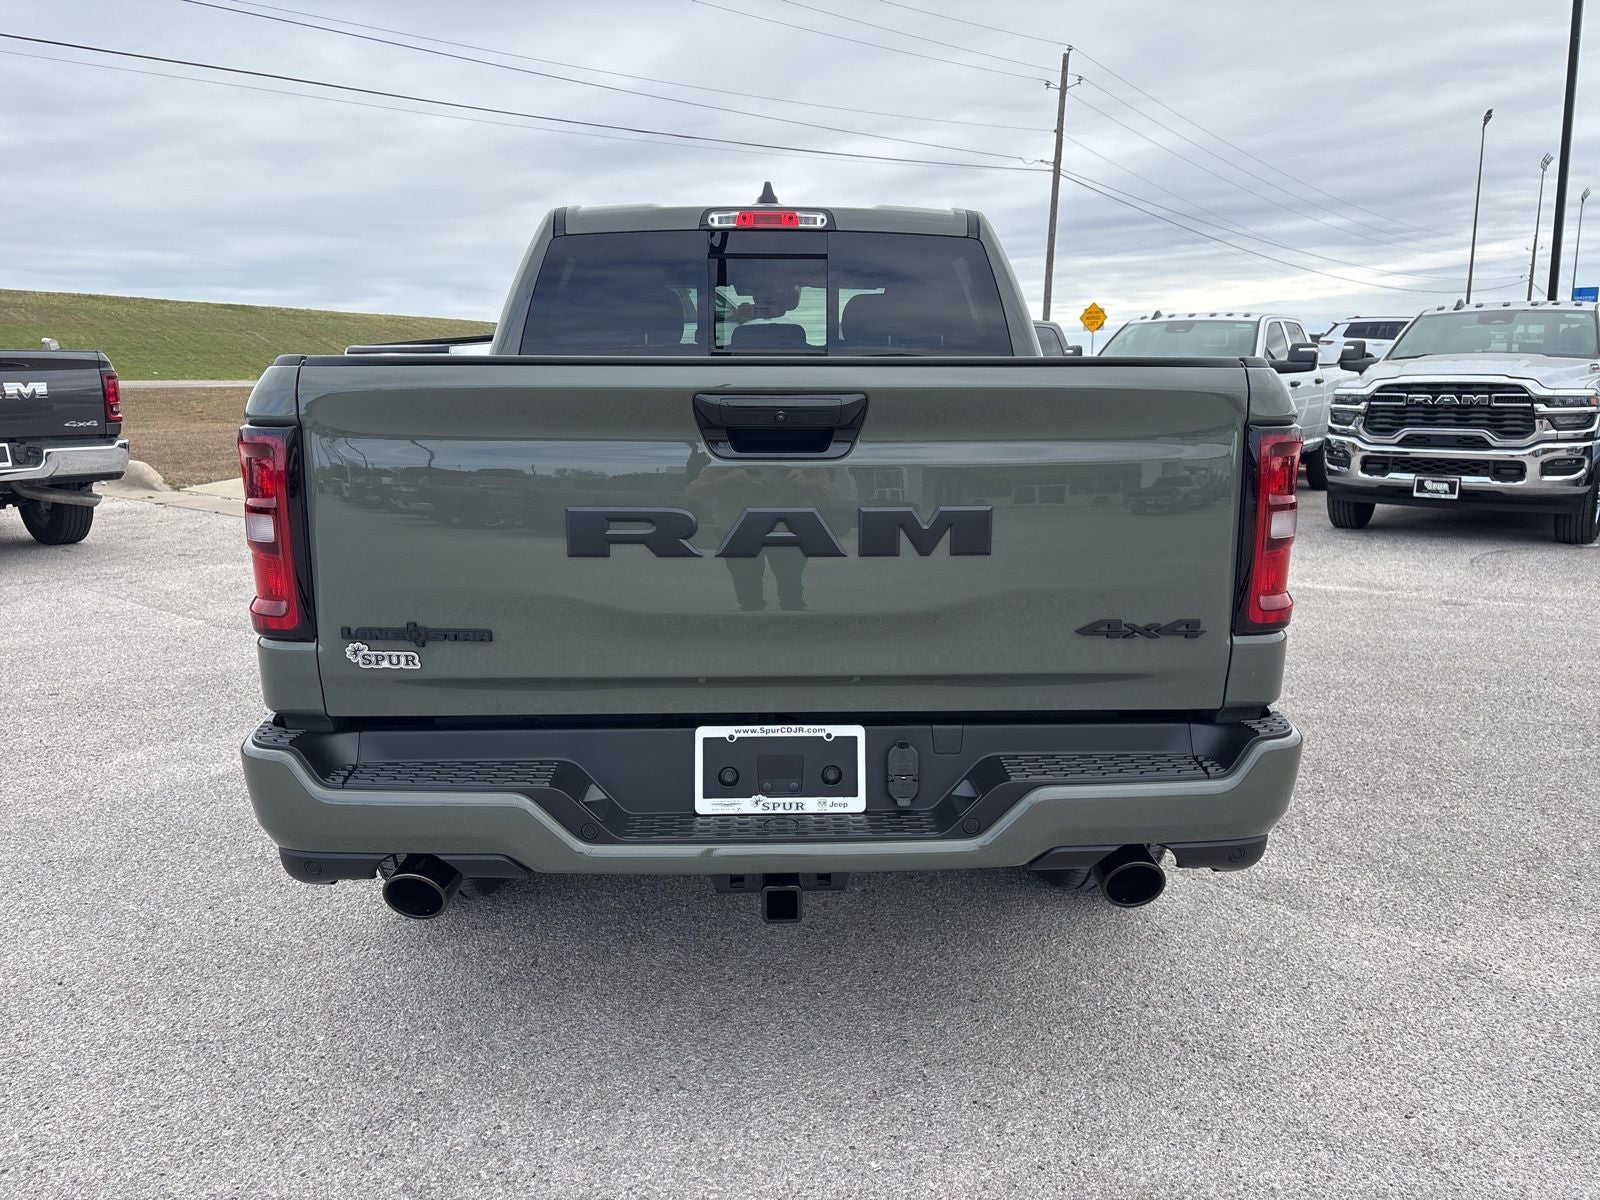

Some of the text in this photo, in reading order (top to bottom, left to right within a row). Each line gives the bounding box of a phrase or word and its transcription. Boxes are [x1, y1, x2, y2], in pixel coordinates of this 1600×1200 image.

[1407, 394, 1489, 405] RAM
[565, 505, 993, 558] RAM
[340, 626, 494, 642] LONE STAR
[1075, 618, 1208, 639] 4x4
[361, 653, 418, 666] SPUR
[734, 726, 826, 735] www.SpurCDJR.com
[761, 801, 806, 812] SPUR
[828, 801, 849, 809] Jeep
